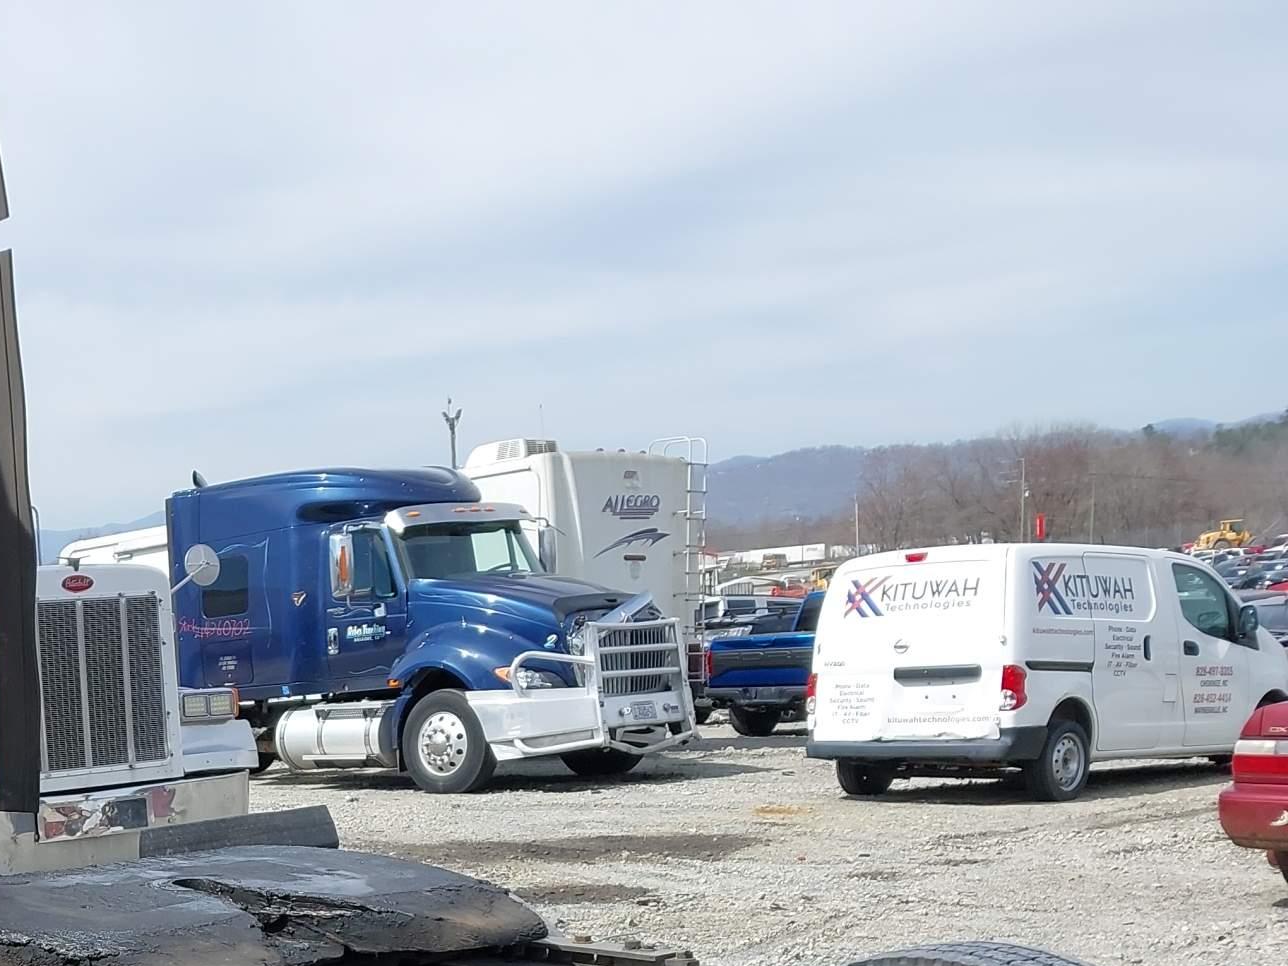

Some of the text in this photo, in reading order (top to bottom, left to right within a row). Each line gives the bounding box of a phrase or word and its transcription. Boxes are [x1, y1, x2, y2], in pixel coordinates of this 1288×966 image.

[601, 495, 660, 513] ALLEGRO
[880, 577, 980, 602] KITUWAH
[1063, 574, 1135, 600] KITUWAH
[885, 599, 971, 612] Technologies
[1070, 599, 1133, 613] Technologies
[544, 634, 558, 649] 2
